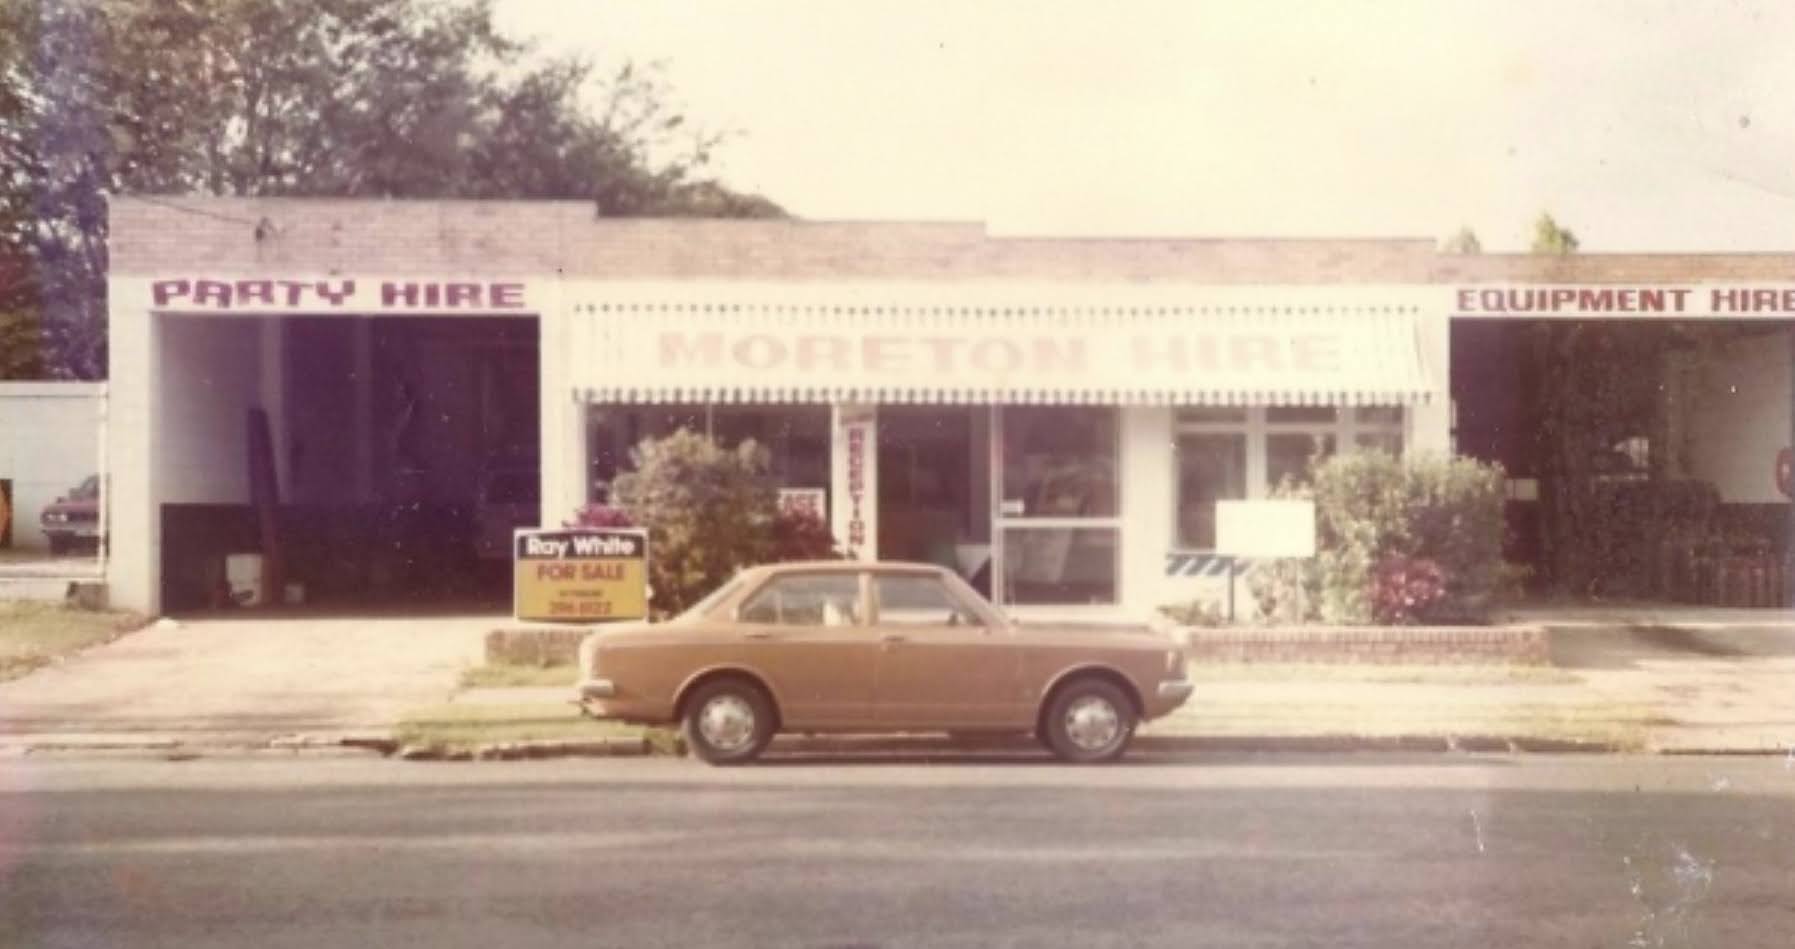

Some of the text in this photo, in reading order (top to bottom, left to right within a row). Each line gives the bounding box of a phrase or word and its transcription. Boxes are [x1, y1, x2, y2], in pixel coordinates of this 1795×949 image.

[152, 280, 526, 309] PARTY HIRE
[1457, 288, 1693, 312] EQUIPMENT
[658, 332, 1342, 372] MORETON HIRE
[848, 427, 865, 546] RECEPTION
[527, 536, 636, 560] Ray White
[537, 563, 626, 581] FOR SALE
